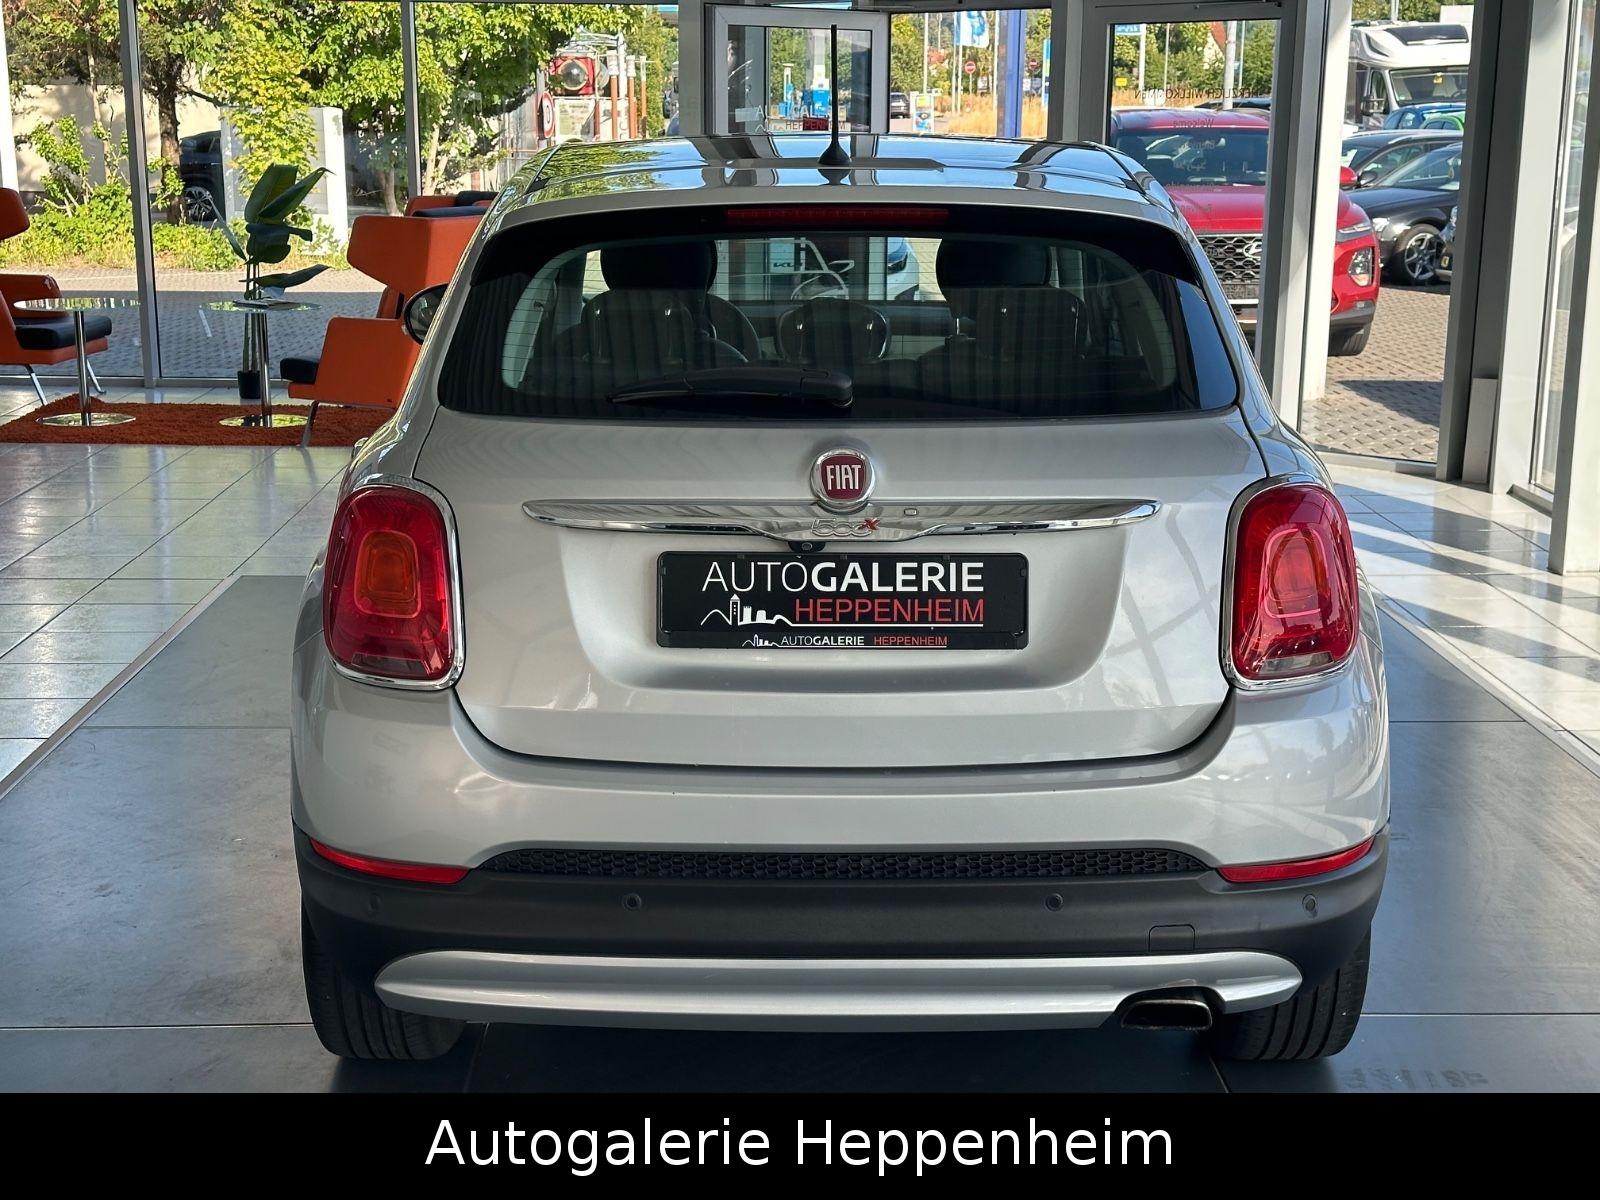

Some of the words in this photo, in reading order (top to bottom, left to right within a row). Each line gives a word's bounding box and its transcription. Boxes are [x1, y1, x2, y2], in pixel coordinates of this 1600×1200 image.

[786, 121, 846, 130] HEPPENHM
[826, 465, 861, 490] FIAT
[702, 561, 984, 592] AUTOGALERIE
[795, 599, 984, 622] HEPPENHEIM
[781, 636, 865, 646] AUTOGALERIE
[874, 636, 948, 646] HEPPENHEIM
